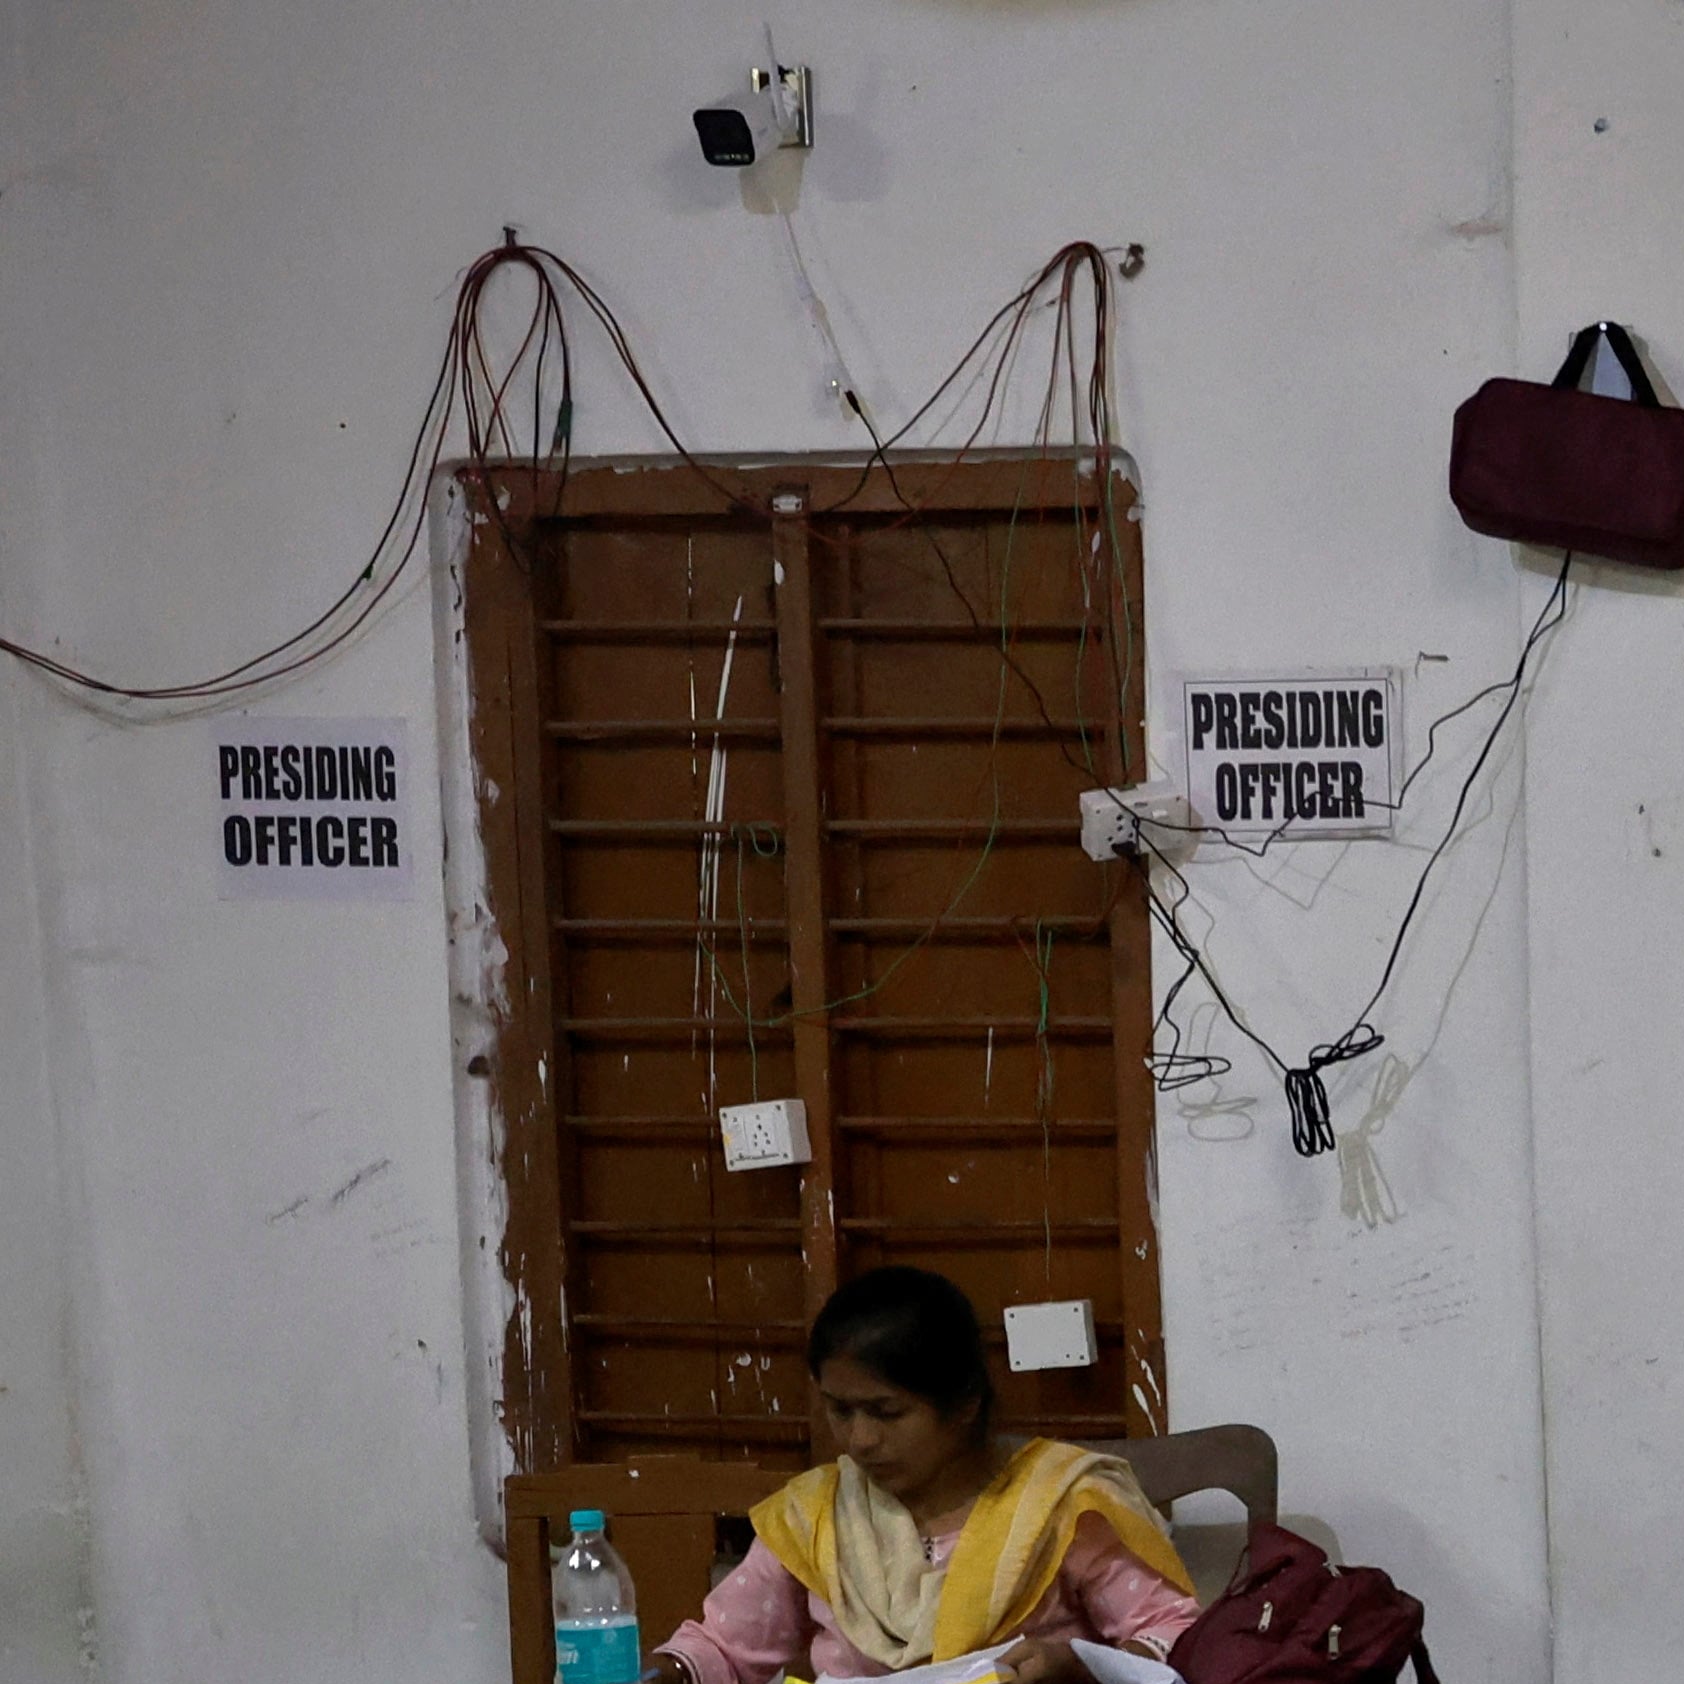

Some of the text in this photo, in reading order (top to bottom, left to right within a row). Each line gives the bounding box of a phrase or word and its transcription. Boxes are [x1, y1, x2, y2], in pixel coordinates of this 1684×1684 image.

[1191, 688, 1385, 751] PRESIDING
[219, 745, 397, 802] PRESIDING
[1215, 760, 1366, 822] OFFICER
[223, 814, 400, 868] OFFICER
